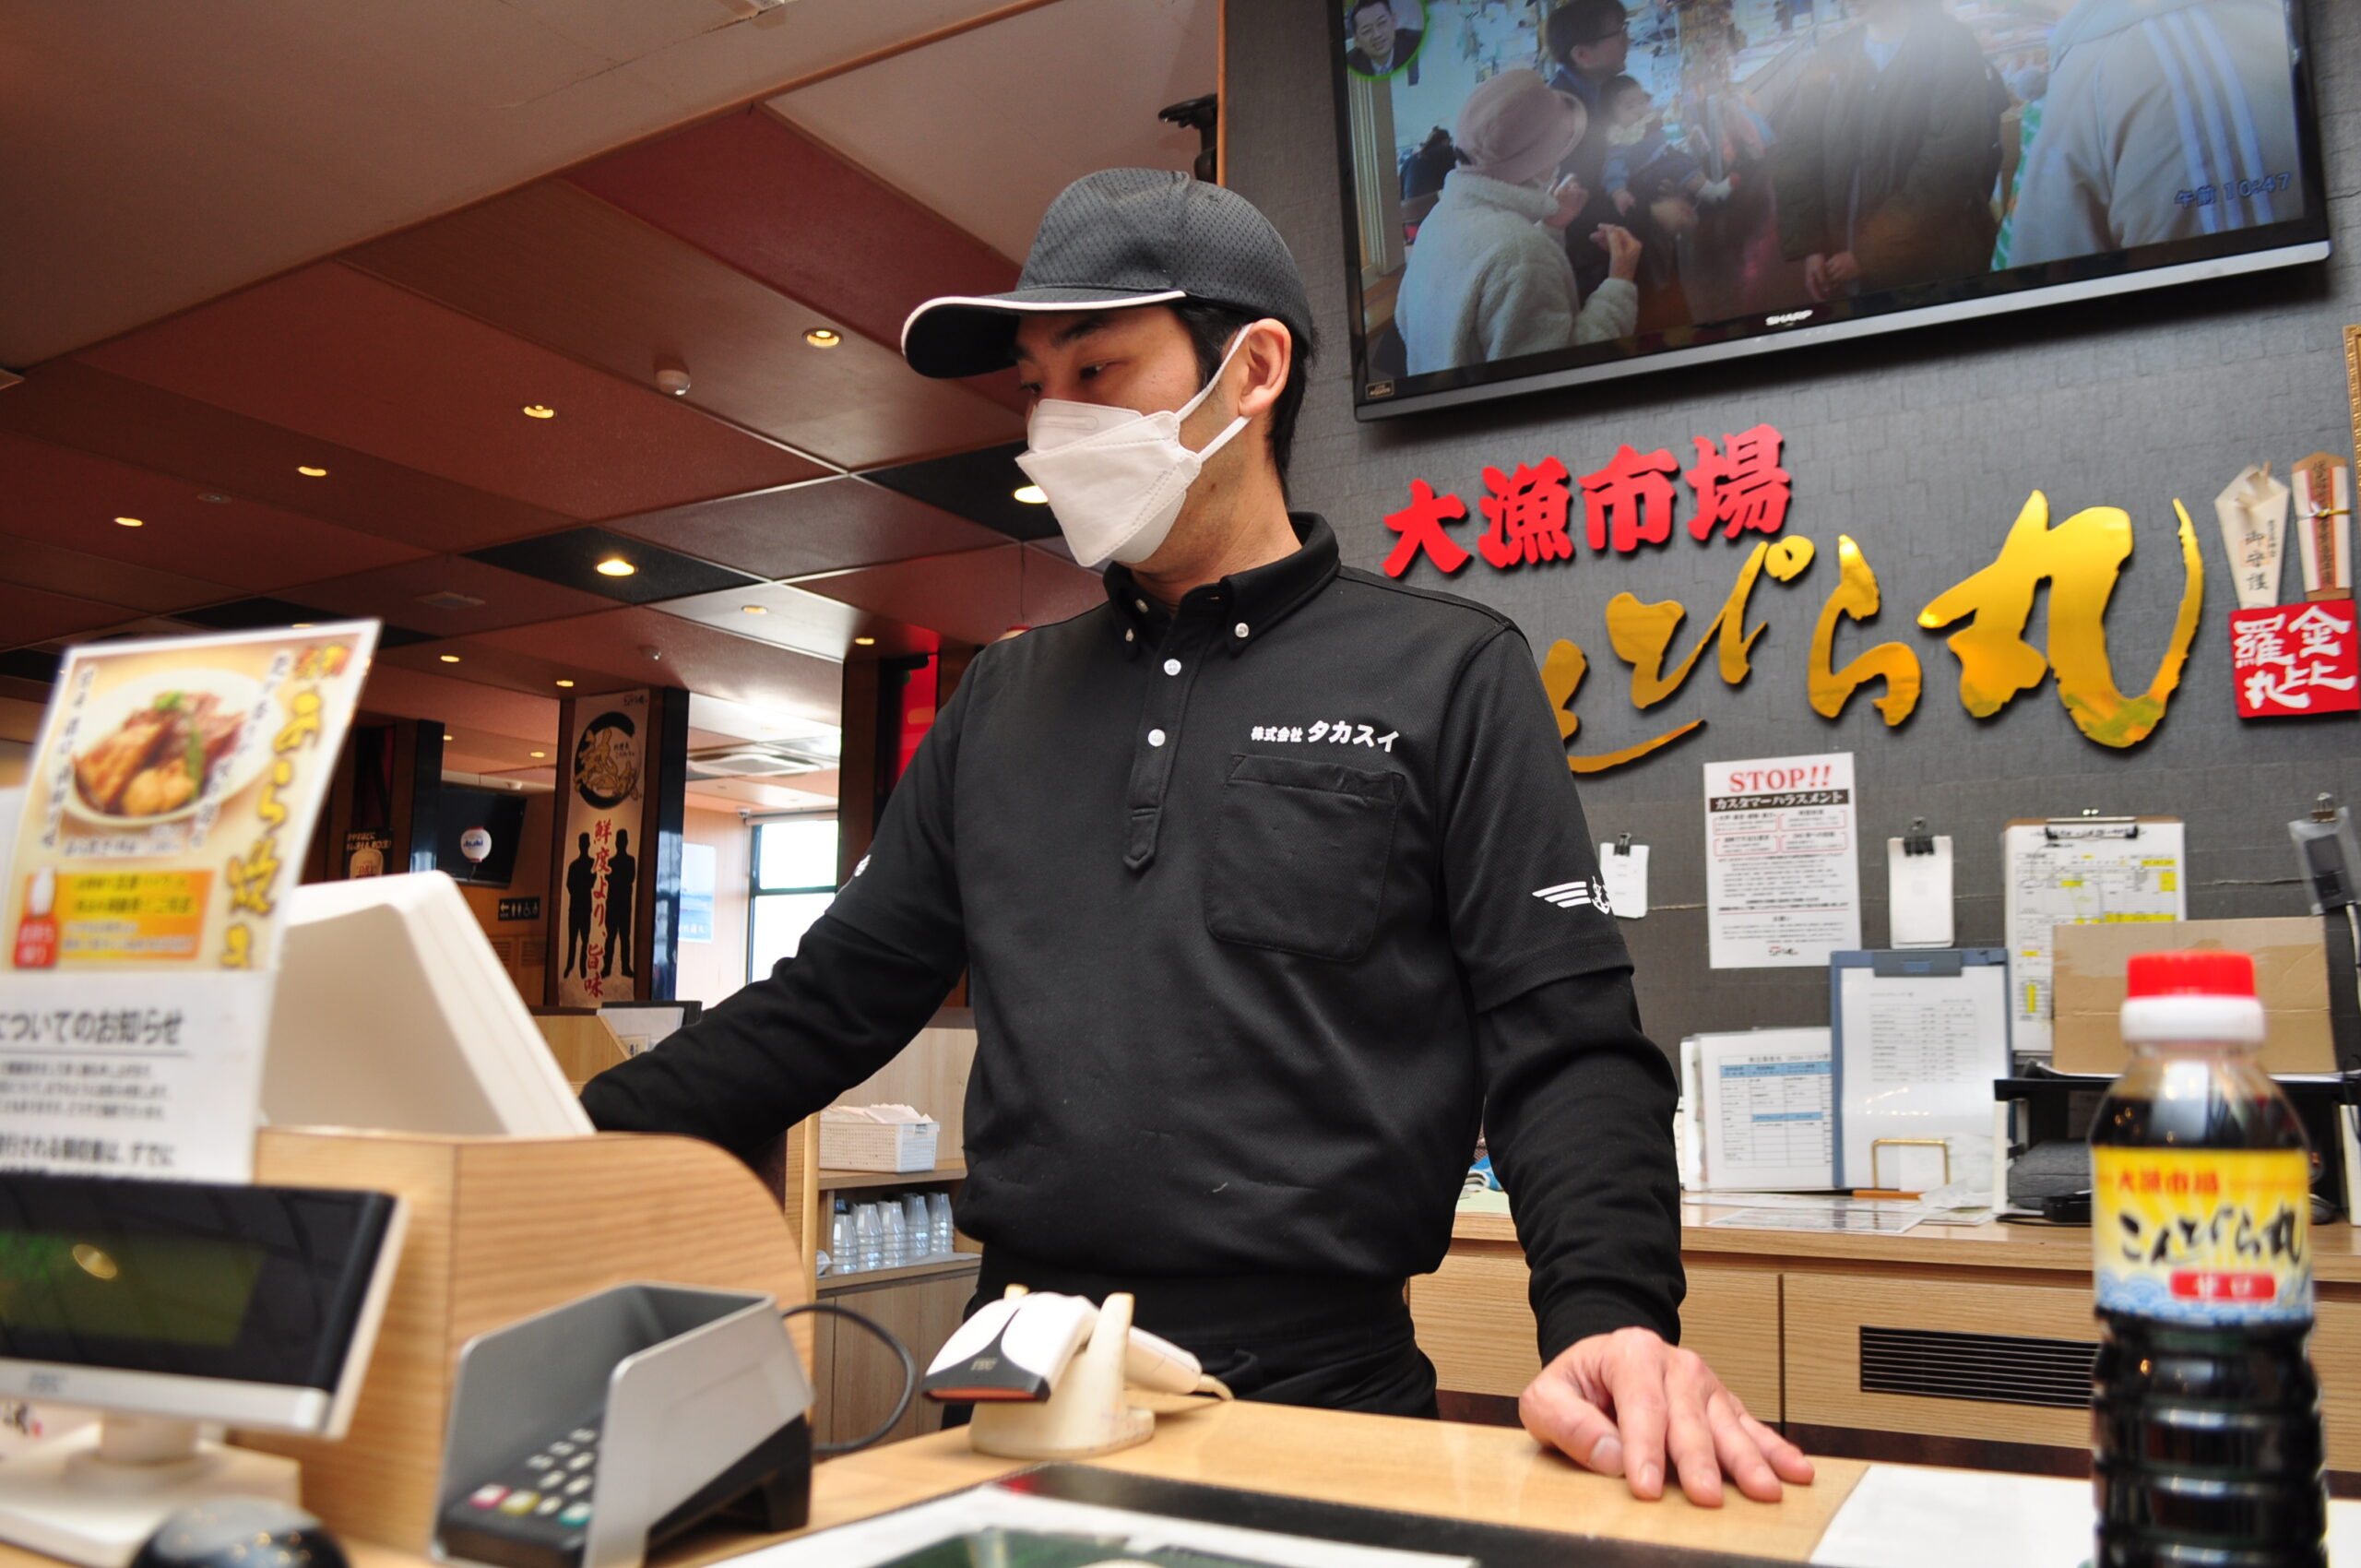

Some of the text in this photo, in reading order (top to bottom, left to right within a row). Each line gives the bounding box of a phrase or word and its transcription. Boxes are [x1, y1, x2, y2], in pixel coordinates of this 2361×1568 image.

[2174, 172, 2293, 208] 午前 10:47
[1382, 423, 1791, 578] 大漁市場
[1251, 719, 1400, 753] 株式会社 タカスイ
[1728, 765, 1833, 793] STOP!!
[1714, 791, 1844, 811] カスタマーハラスメント
[584, 818, 613, 998] 鮮度より、旨味
